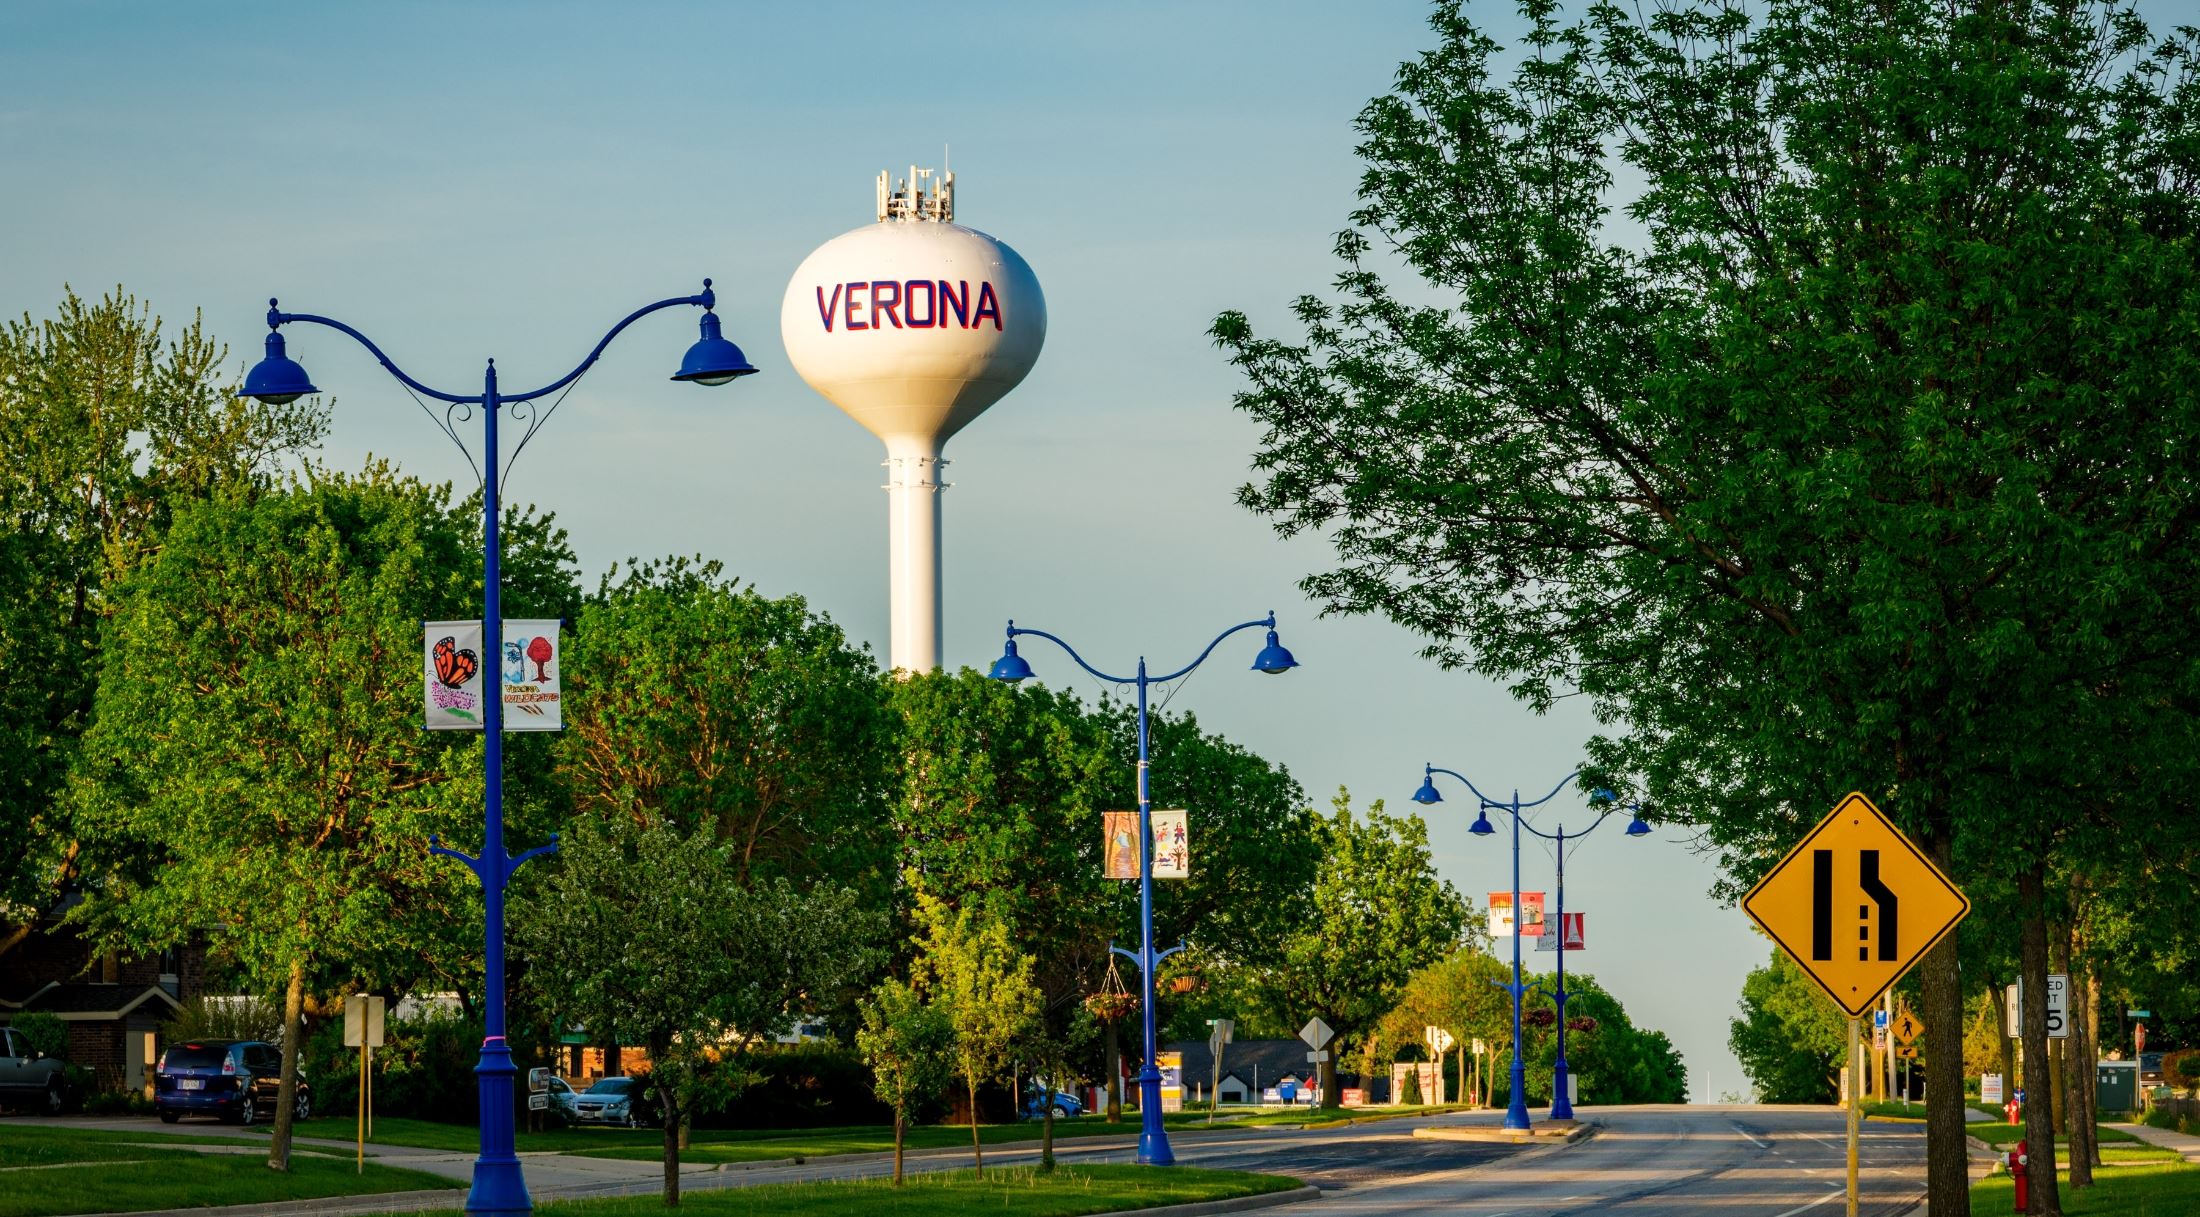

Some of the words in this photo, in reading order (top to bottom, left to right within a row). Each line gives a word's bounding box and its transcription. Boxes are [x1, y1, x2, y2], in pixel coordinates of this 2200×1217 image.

[816, 280, 1003, 333] VERONA
[504, 692, 560, 703] WILDCATS
[2047, 1009, 2063, 1031] 5
